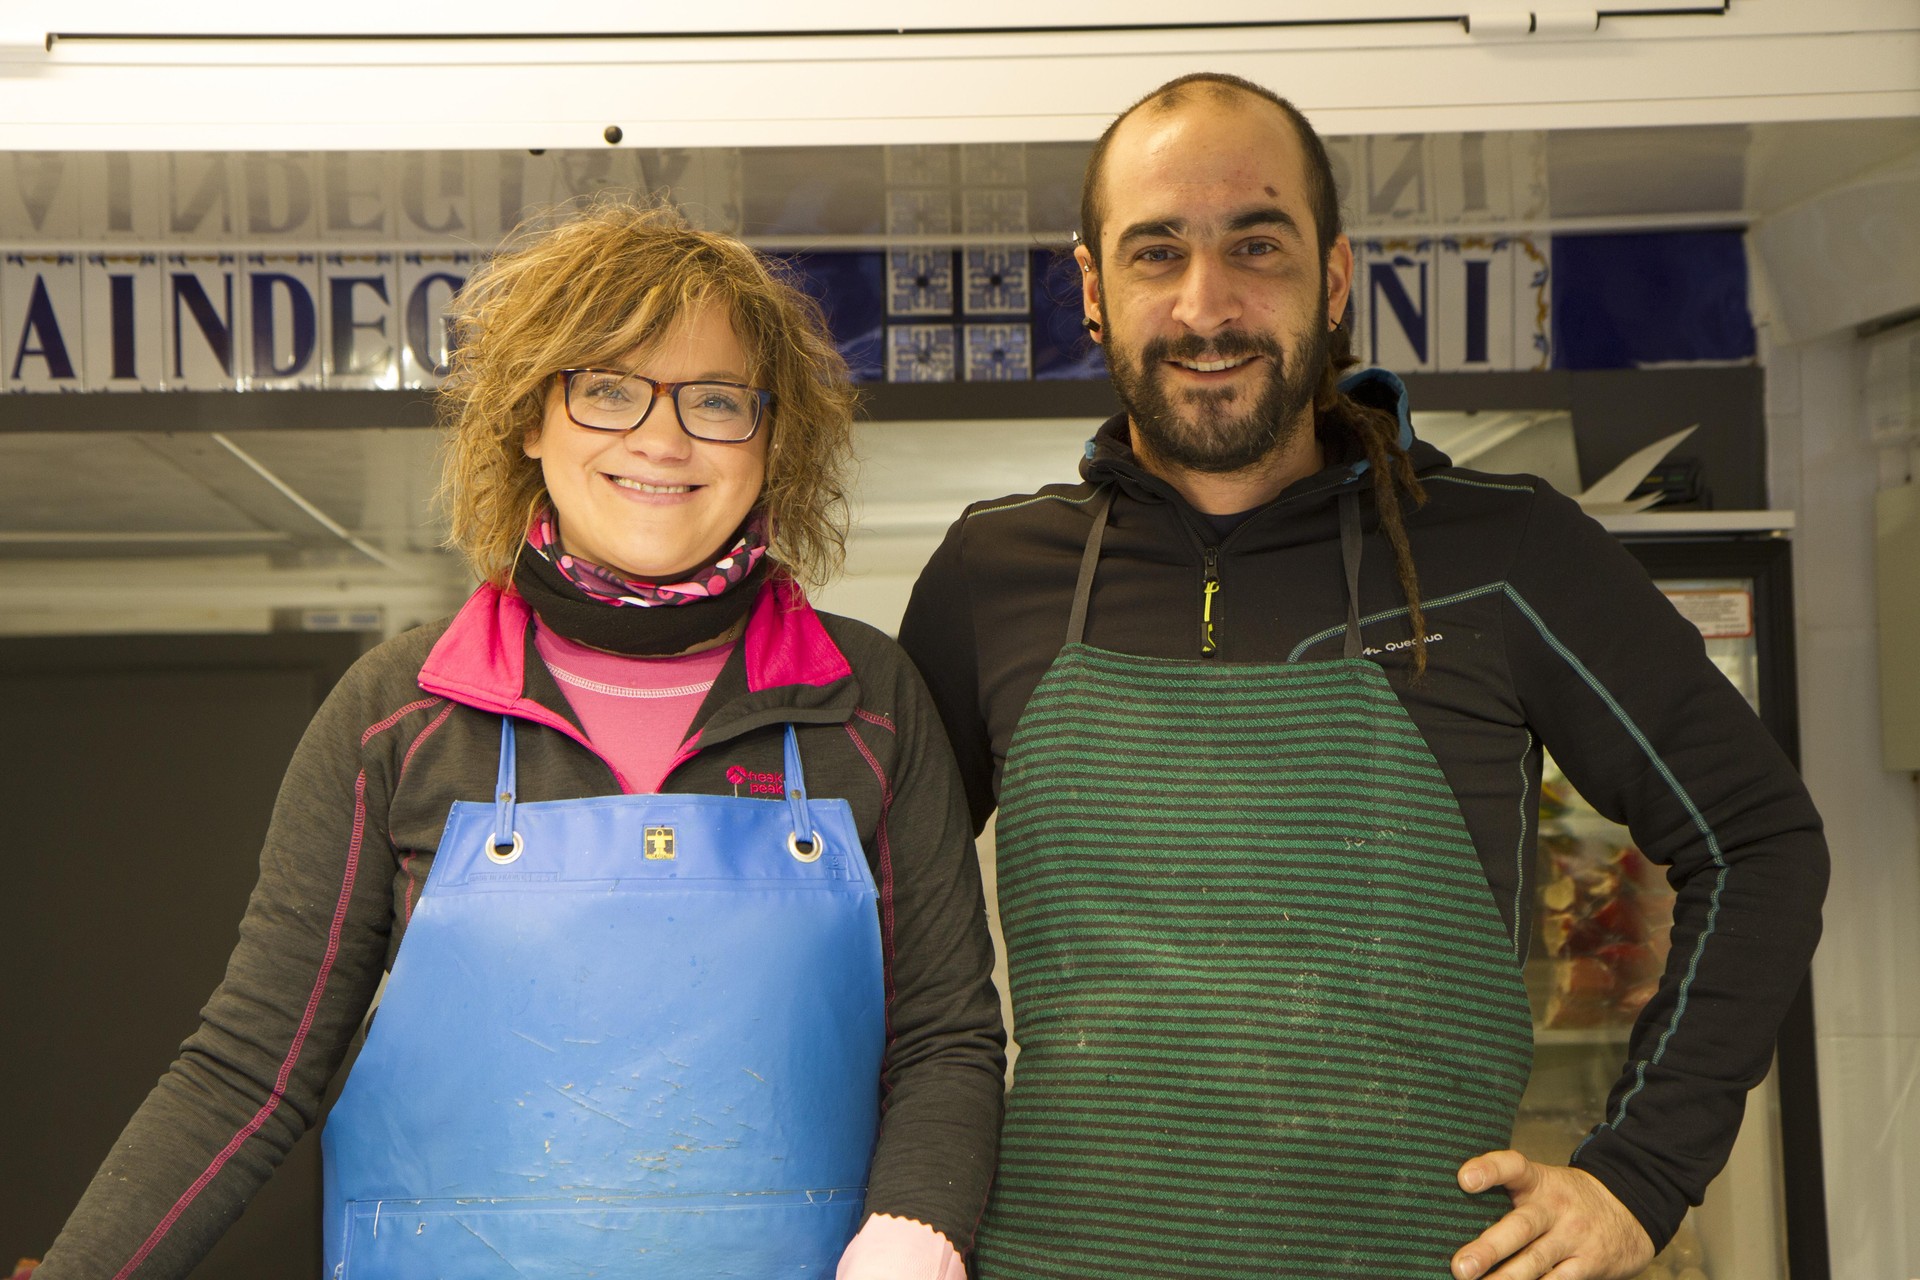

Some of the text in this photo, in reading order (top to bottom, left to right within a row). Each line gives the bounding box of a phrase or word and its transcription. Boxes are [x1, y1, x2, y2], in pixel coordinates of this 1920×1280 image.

[11, 256, 1490, 379] AINDEG ÑI
[750, 783, 784, 795] peak
